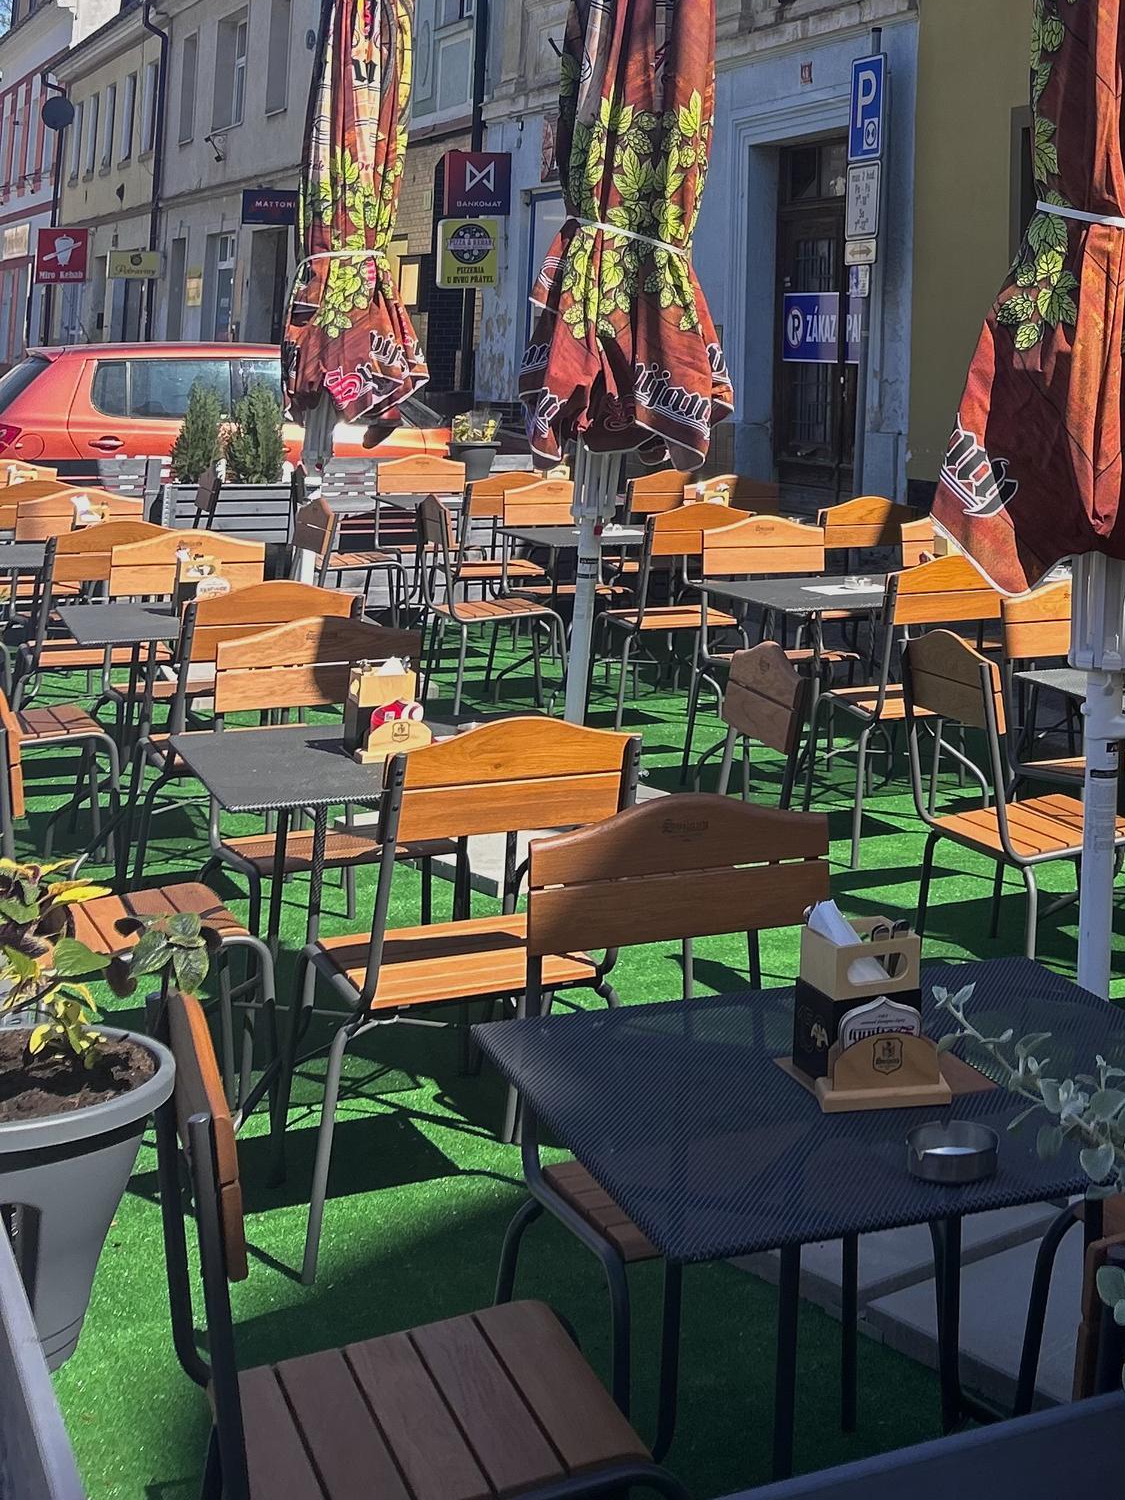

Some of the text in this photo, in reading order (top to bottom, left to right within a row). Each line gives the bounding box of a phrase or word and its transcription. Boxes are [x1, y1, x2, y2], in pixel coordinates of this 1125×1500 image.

[857, 70, 877, 128] P
[456, 200, 502, 208] BANKOMAT
[39, 270, 84, 279] Miro Kebab
[806, 305, 837, 343] ZÁKAZ
